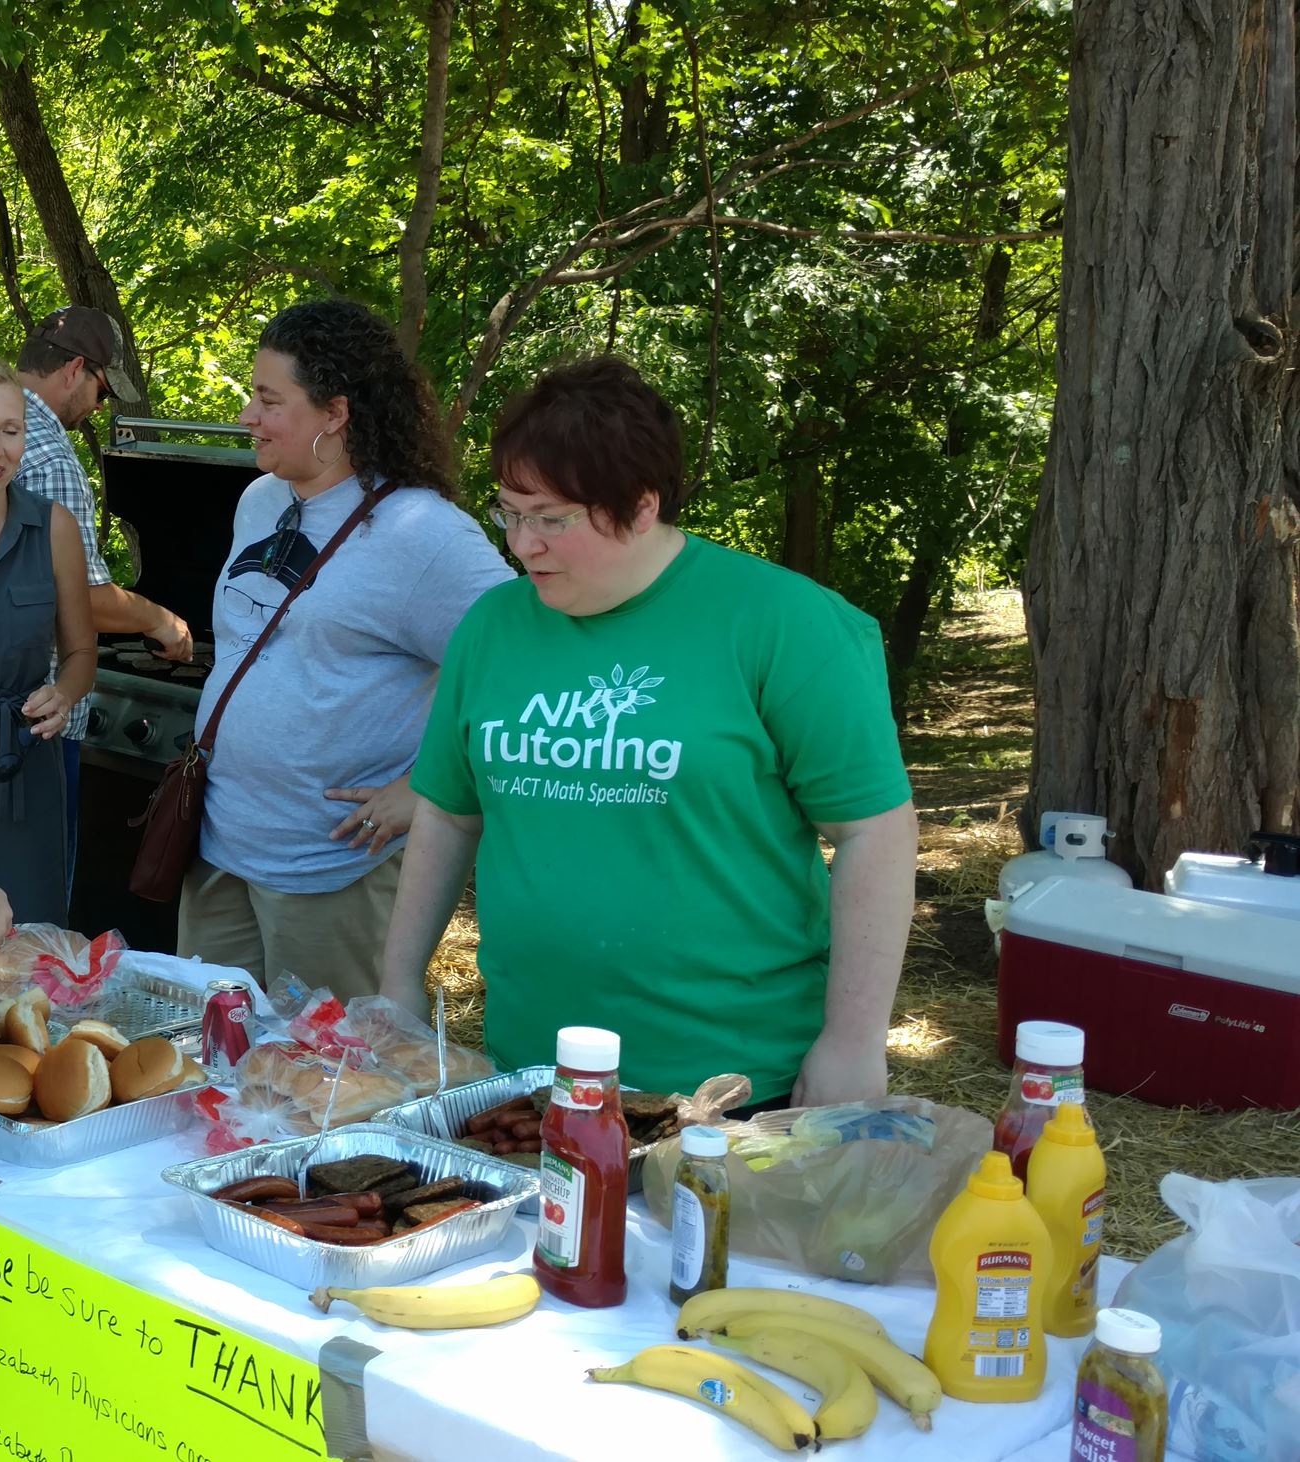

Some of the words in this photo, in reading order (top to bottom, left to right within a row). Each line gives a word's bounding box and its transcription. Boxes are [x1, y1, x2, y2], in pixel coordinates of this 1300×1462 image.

[519, 688, 639, 729] NKY
[480, 719, 683, 781] Tutoring
[510, 776, 541, 797] ACT
[543, 779, 585, 802] Math
[587, 782, 669, 807] Specialists
[1252, 1023, 1266, 1034] 48
[980, 1255, 1029, 1267] BURMANS
[25, 1253, 54, 1300] be
[135, 1319, 164, 1356] to
[173, 1318, 327, 1444] THANK
[71, 1371, 167, 1451] Physicians
[1078, 1421, 1117, 1453] Sweet
